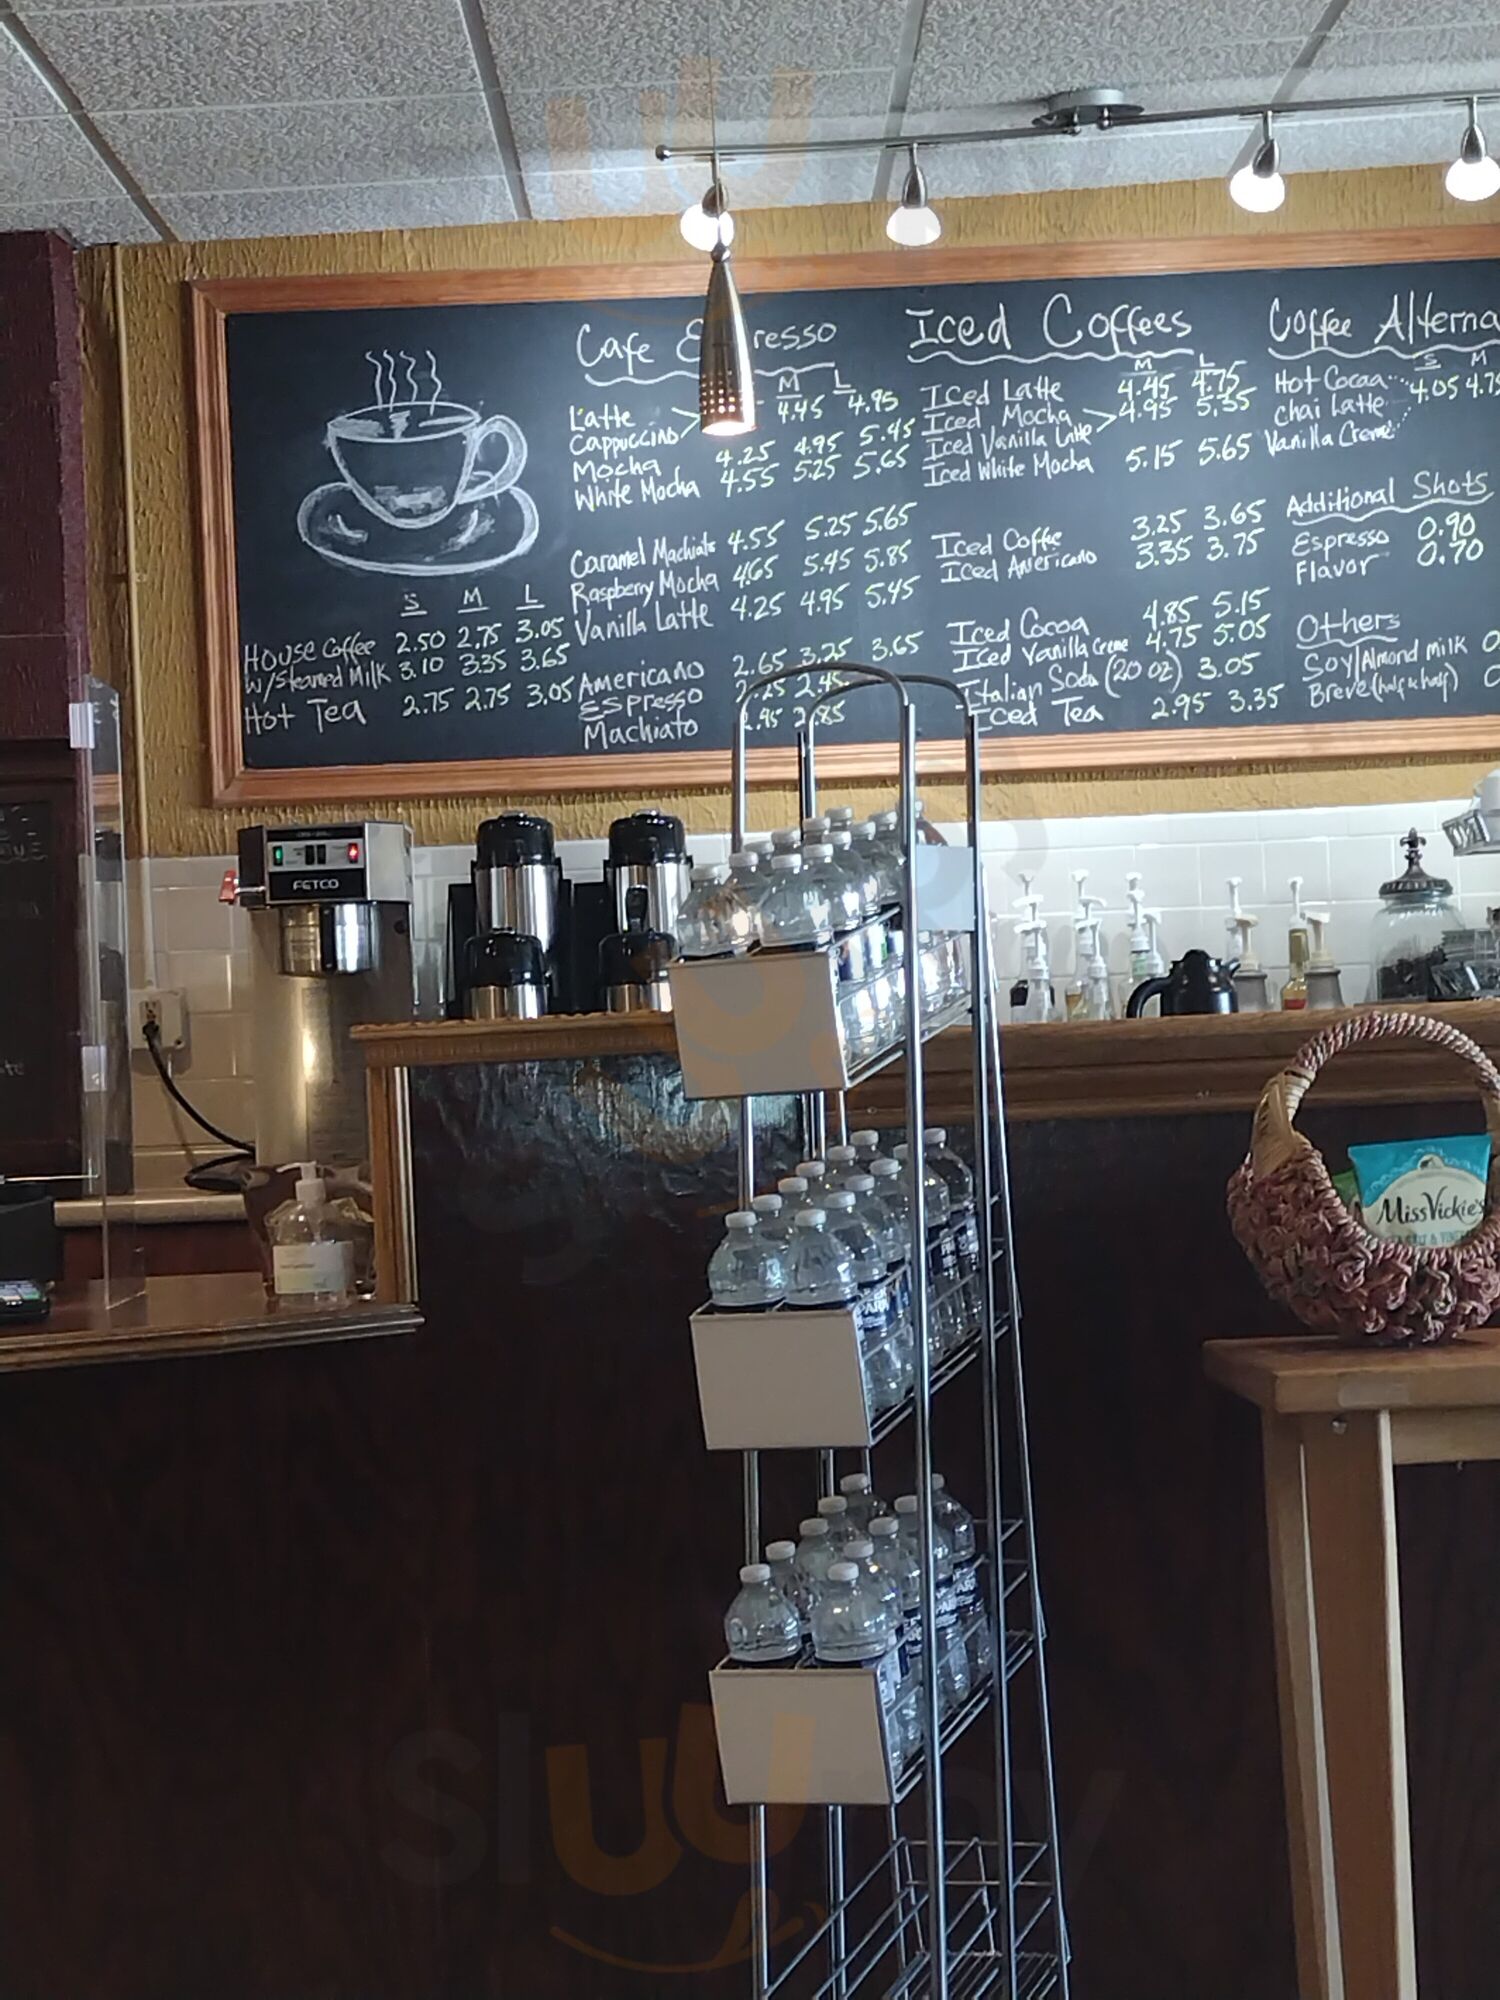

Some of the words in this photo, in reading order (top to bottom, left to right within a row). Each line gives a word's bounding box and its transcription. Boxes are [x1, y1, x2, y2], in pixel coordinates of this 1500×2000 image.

[577, 323, 654, 374] Cafe
[676, 319, 836, 363] Eresso
[905, 302, 1011, 350] Iced
[1043, 293, 1193, 354] Coffees
[1269, 297, 1352, 351] Coffee
[778, 372, 800, 393] M
[834, 369, 851, 390] L
[1134, 358, 1152, 371] M
[1471, 349, 1487, 367] M
[920, 379, 989, 412] Iced
[1003, 375, 1064, 402] Latte
[1117, 373, 1176, 401] 4.45
[1275, 365, 1320, 394] Hot
[1409, 374, 1459, 404] 4.05
[1331, 392, 1385, 417] Latte
[569, 403, 636, 431] Latte
[777, 394, 827, 424] 4.45
[848, 388, 899, 417] 4.95
[921, 407, 981, 436] Iced
[1002, 401, 1072, 427] Mocha
[1119, 396, 1178, 423] 4.95
[573, 455, 661, 483] Mocha
[715, 440, 776, 468] 4.25
[794, 431, 844, 456] 4.95
[859, 417, 916, 446] 5.45
[922, 459, 971, 487] Iced
[978, 455, 1025, 481] White
[1033, 448, 1094, 480] Mocha
[1125, 439, 1183, 472] 5.15
[1198, 432, 1252, 466] 5.65
[923, 431, 973, 461] Iced
[980, 425, 1047, 460] Vanilla
[1265, 422, 1334, 457] Vanilla
[574, 477, 633, 512] White
[640, 465, 701, 504] Mocha
[720, 463, 780, 498] 4.55
[793, 454, 842, 482] 5.25
[853, 443, 910, 480] 5.65
[1286, 476, 1395, 518] Additional
[1412, 470, 1488, 499] Shots
[570, 536, 646, 579] Caramel
[727, 519, 785, 551] 4.55
[804, 512, 858, 541] 5.25
[862, 502, 918, 536] 5.65
[930, 532, 992, 559] Iced
[1130, 508, 1188, 541] 3.25
[1203, 498, 1266, 530] 3.65
[1291, 529, 1390, 562] Espresso
[1418, 511, 1475, 541] 0.90
[570, 577, 655, 615] Raspberry
[659, 565, 720, 599] Mocha
[732, 554, 779, 588] 4.65
[802, 547, 855, 577] 5.45
[863, 538, 912, 574] 5.85
[940, 558, 999, 583] Iced
[1135, 535, 1193, 571] 3.35
[1206, 527, 1265, 562] 3.75
[1296, 552, 1383, 585] Flavor
[1417, 538, 1484, 567] 0.70
[403, 592, 420, 610] S
[463, 586, 483, 607] M
[525, 584, 539, 603] L
[574, 607, 647, 647] Vanilla
[655, 597, 714, 632] Latte
[730, 591, 786, 621] 4.25
[800, 583, 850, 615] 4.95
[864, 575, 921, 609] 5.45
[946, 618, 1010, 645] Iced
[1020, 607, 1090, 638] Cocoa
[1142, 595, 1199, 630] 4.85
[1211, 586, 1271, 619] 5.15
[322, 631, 376, 665] Coffee
[395, 631, 446, 654] 2.50
[457, 623, 502, 649] 2.75
[515, 616, 564, 643] 3.05
[952, 643, 1012, 673] Iced
[1022, 635, 1089, 666] Vanilla
[1145, 624, 1203, 653] 4.75
[1213, 613, 1272, 647] 5.05
[1296, 608, 1400, 643] Others
[350, 660, 392, 690] Milk
[398, 657, 444, 681] 3.10
[459, 649, 507, 676] 3.35
[520, 642, 571, 672] 3.65
[578, 660, 704, 702] Americano
[733, 648, 787, 677] 2.65
[800, 636, 853, 666] 3.25
[872, 630, 924, 662] 3.65
[955, 673, 1043, 709] Italian
[1048, 662, 1099, 693] Soda
[1104, 653, 1142, 698] (20
[1197, 652, 1262, 681] 3.05
[244, 702, 296, 735] Hot
[307, 698, 367, 733] Tea
[402, 687, 455, 716] 2.75
[465, 682, 511, 711] 2.75
[526, 675, 575, 707] 3.05
[970, 700, 1038, 734] Iced
[1051, 696, 1104, 727] Tea
[1151, 691, 1213, 721] 2.95
[1229, 683, 1285, 713] 3.35
[1308, 680, 1372, 708] Breve
[293, 878, 339, 891] FETCO
[1376, 1196, 1427, 1225] Miss
